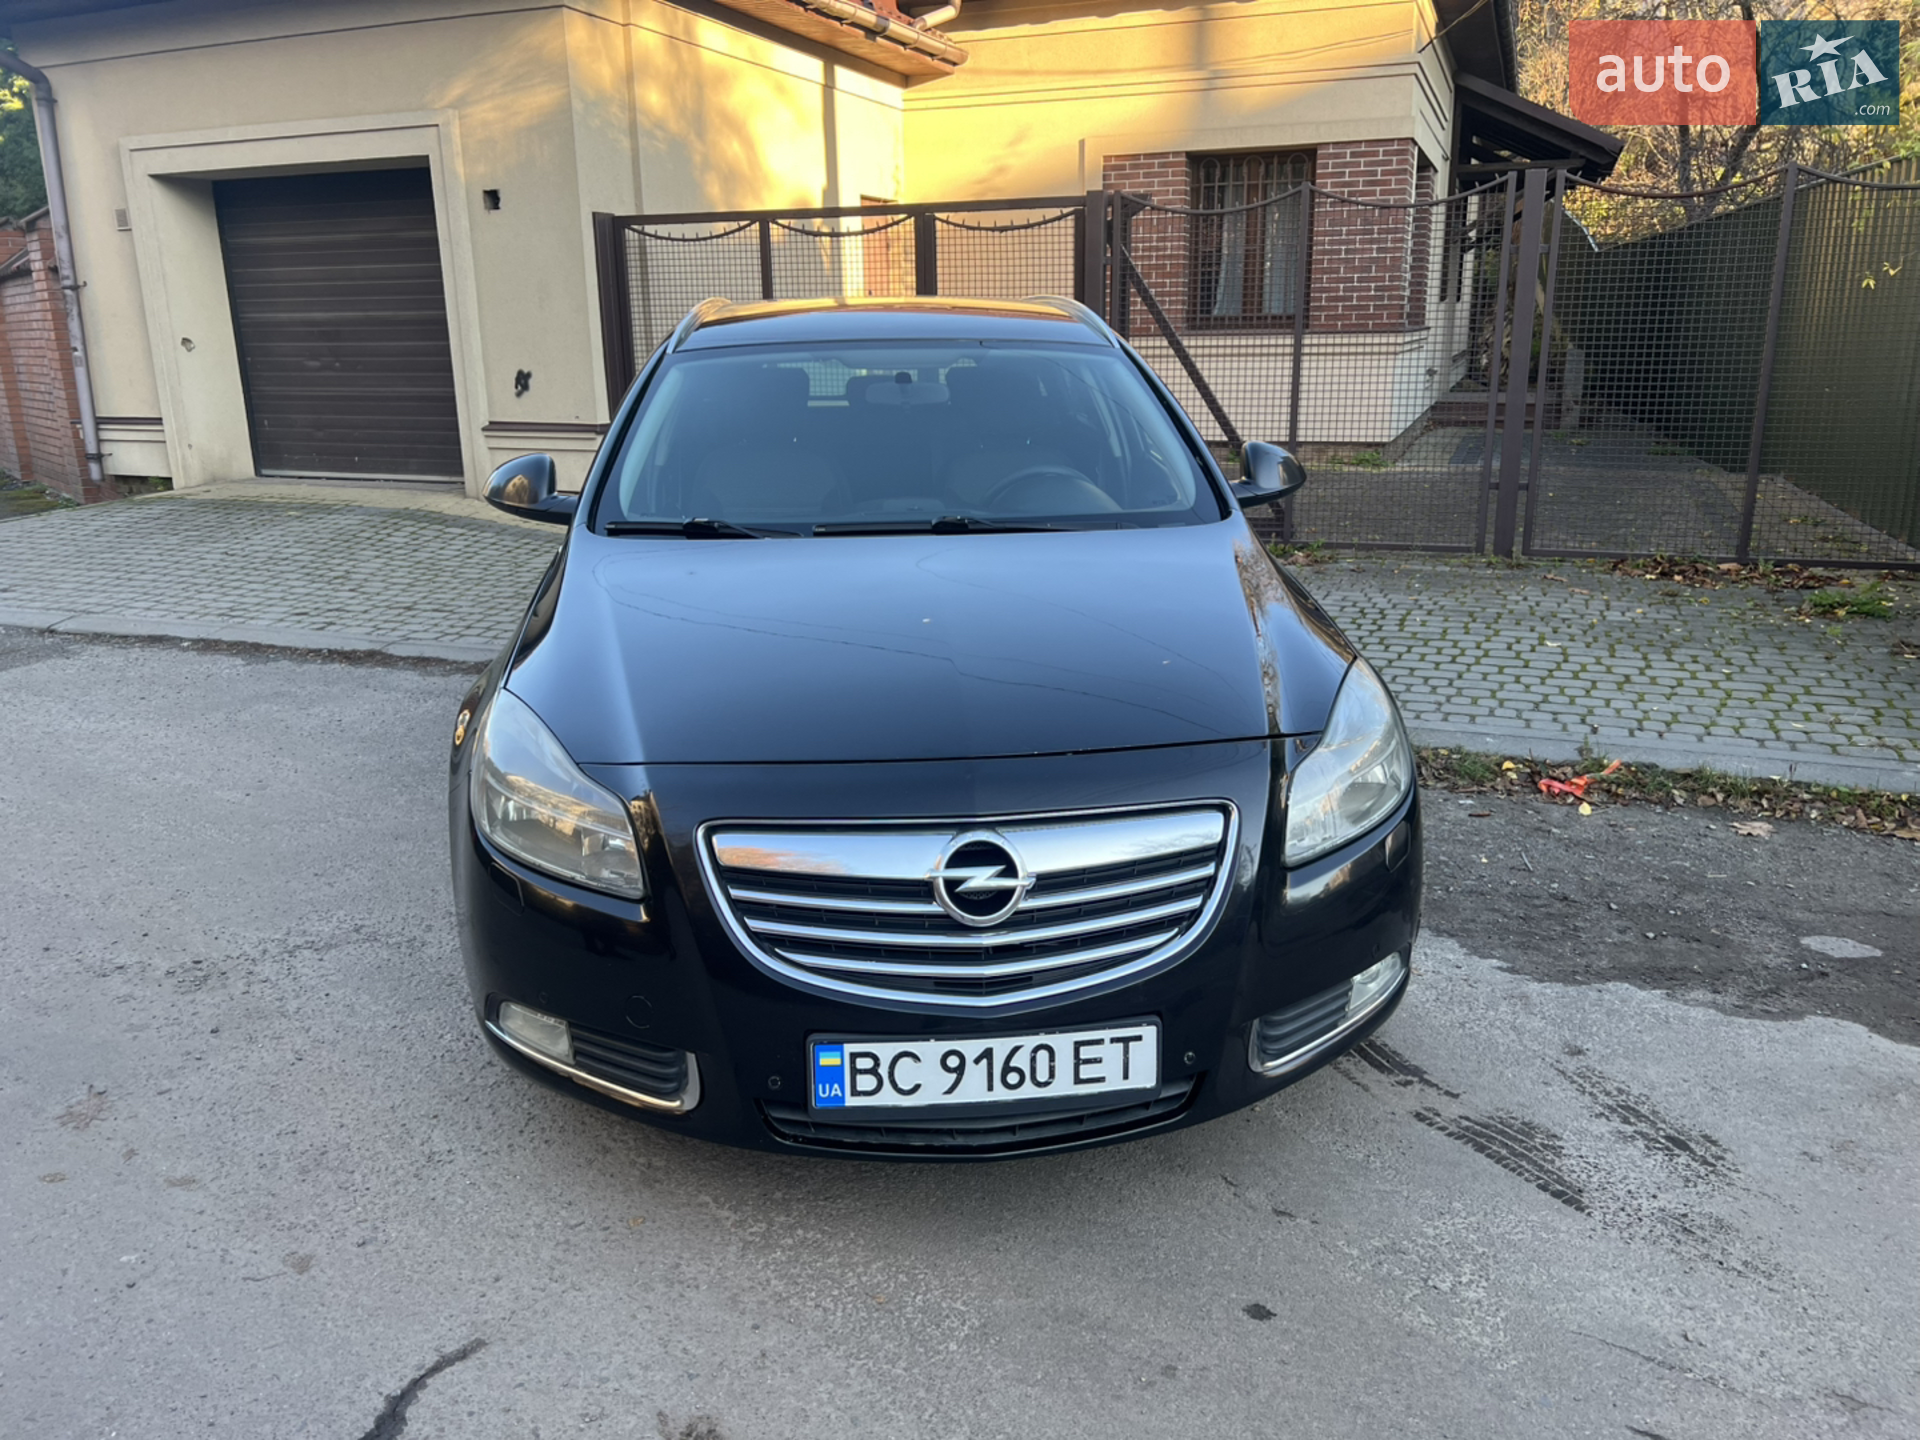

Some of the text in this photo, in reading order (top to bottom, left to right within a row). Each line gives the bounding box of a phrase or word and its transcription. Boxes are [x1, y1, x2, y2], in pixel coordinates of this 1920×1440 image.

[848, 1034, 1143, 1098] BC 9160 ET
[818, 1083, 843, 1099] UA
